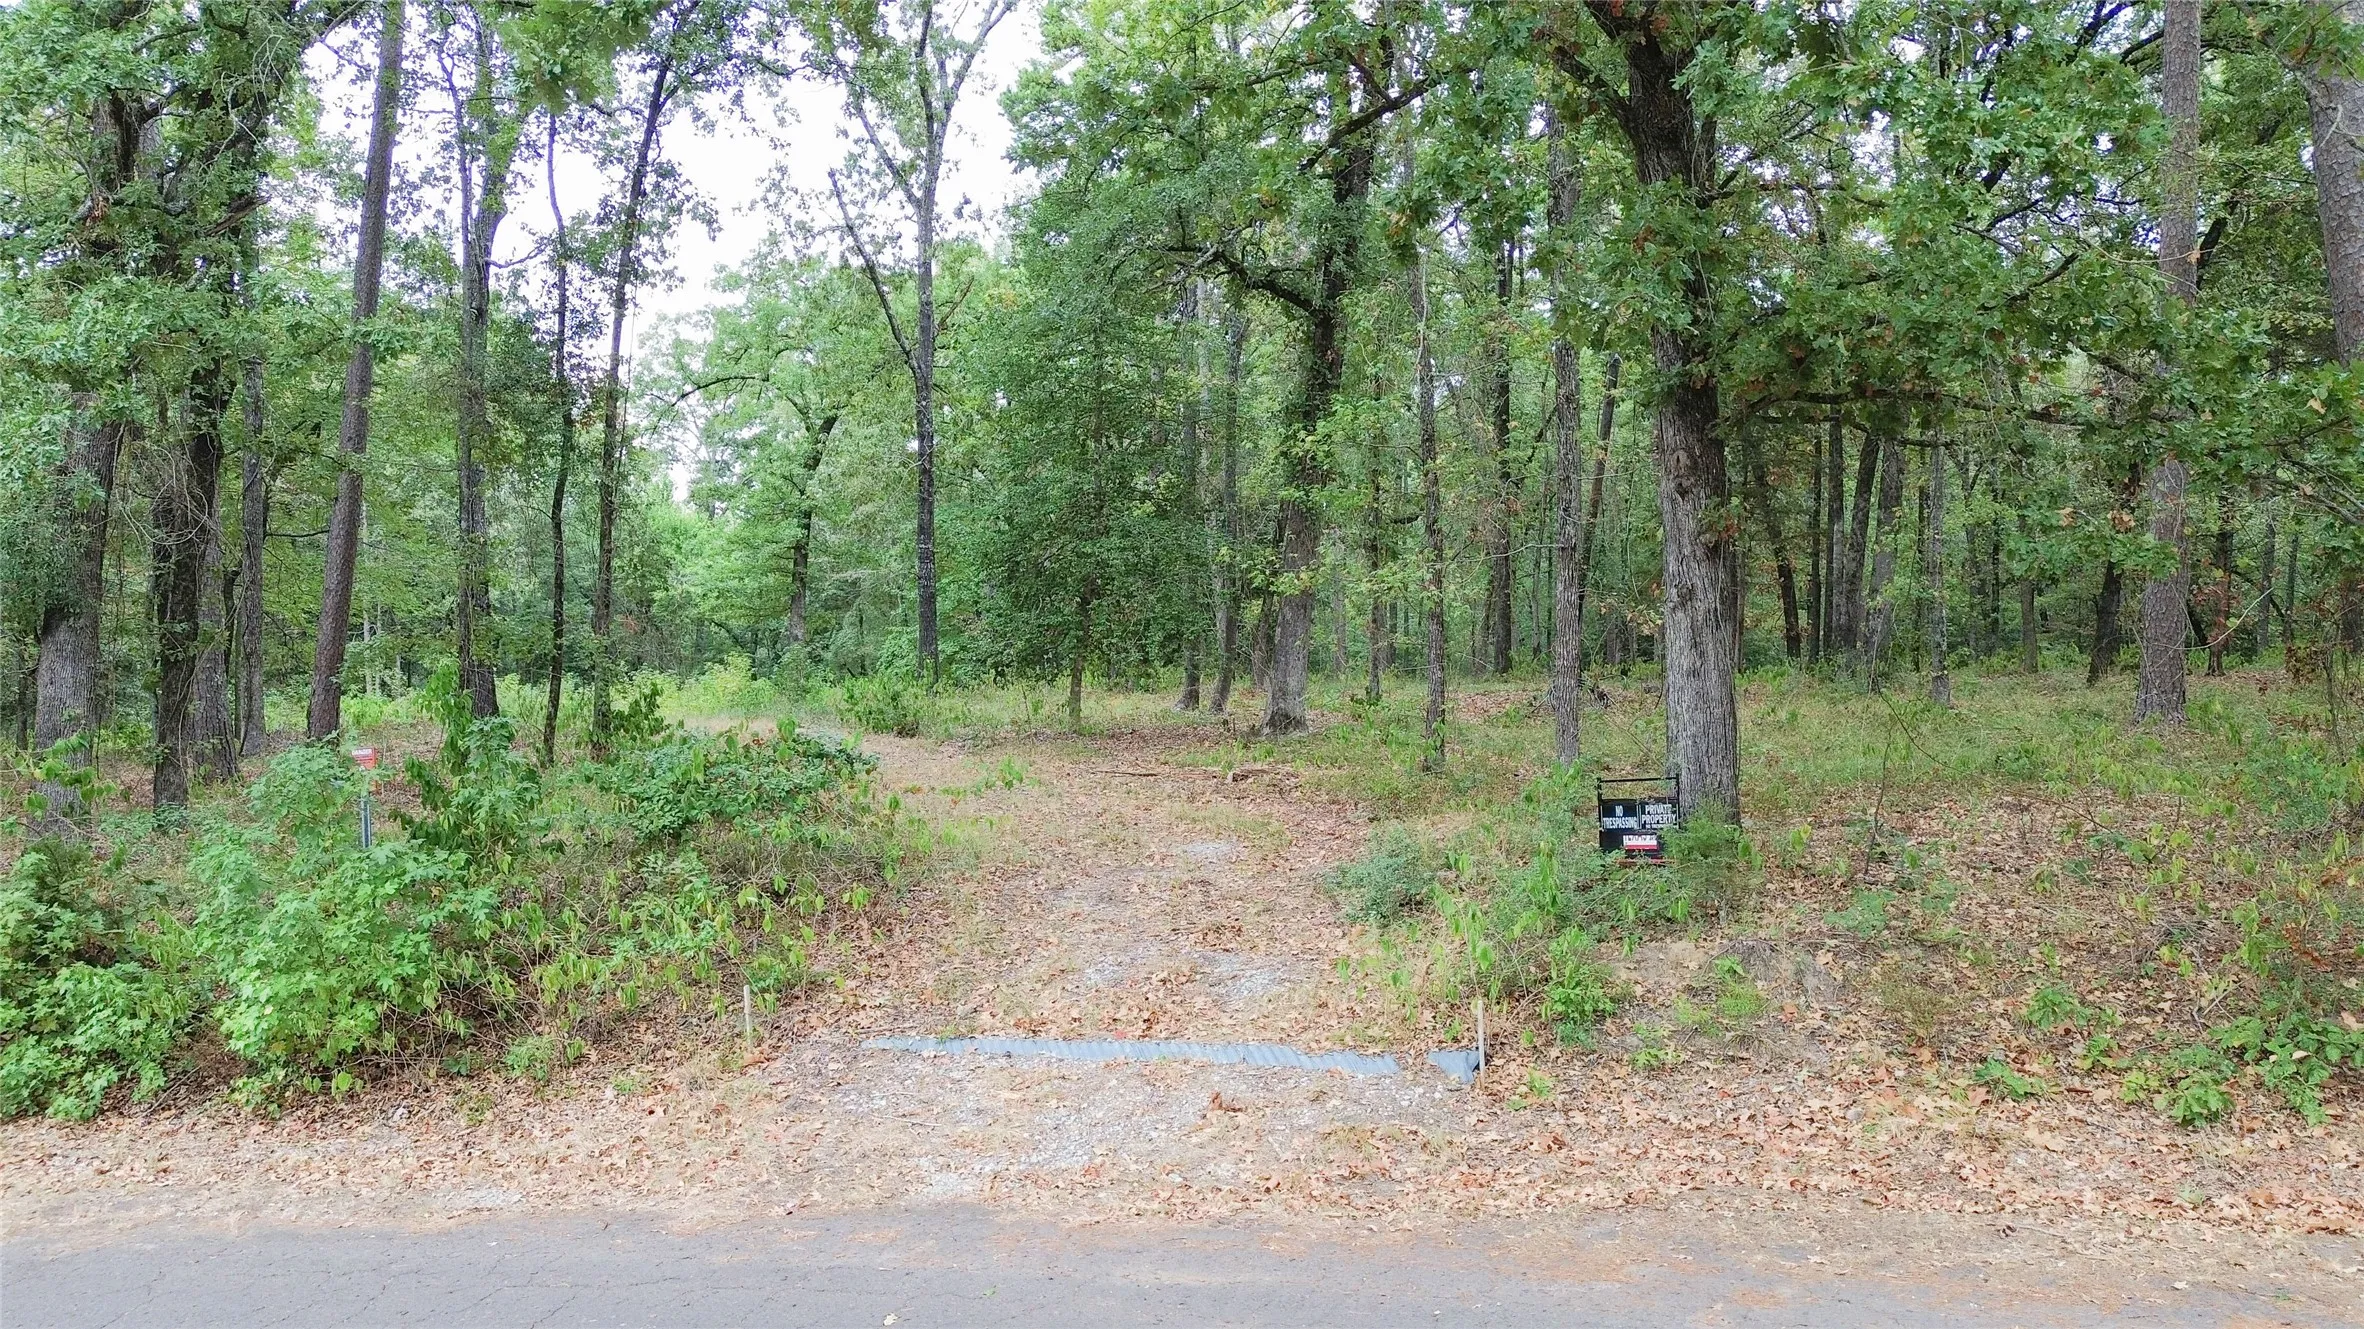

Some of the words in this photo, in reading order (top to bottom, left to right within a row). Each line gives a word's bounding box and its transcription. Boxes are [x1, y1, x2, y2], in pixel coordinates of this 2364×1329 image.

[1615, 805, 1623, 816] NO
[1645, 804, 1672, 814] PRIVATE
[1603, 817, 1637, 829] TRESPASSING
[1641, 814, 1676, 824] PROPERTY
